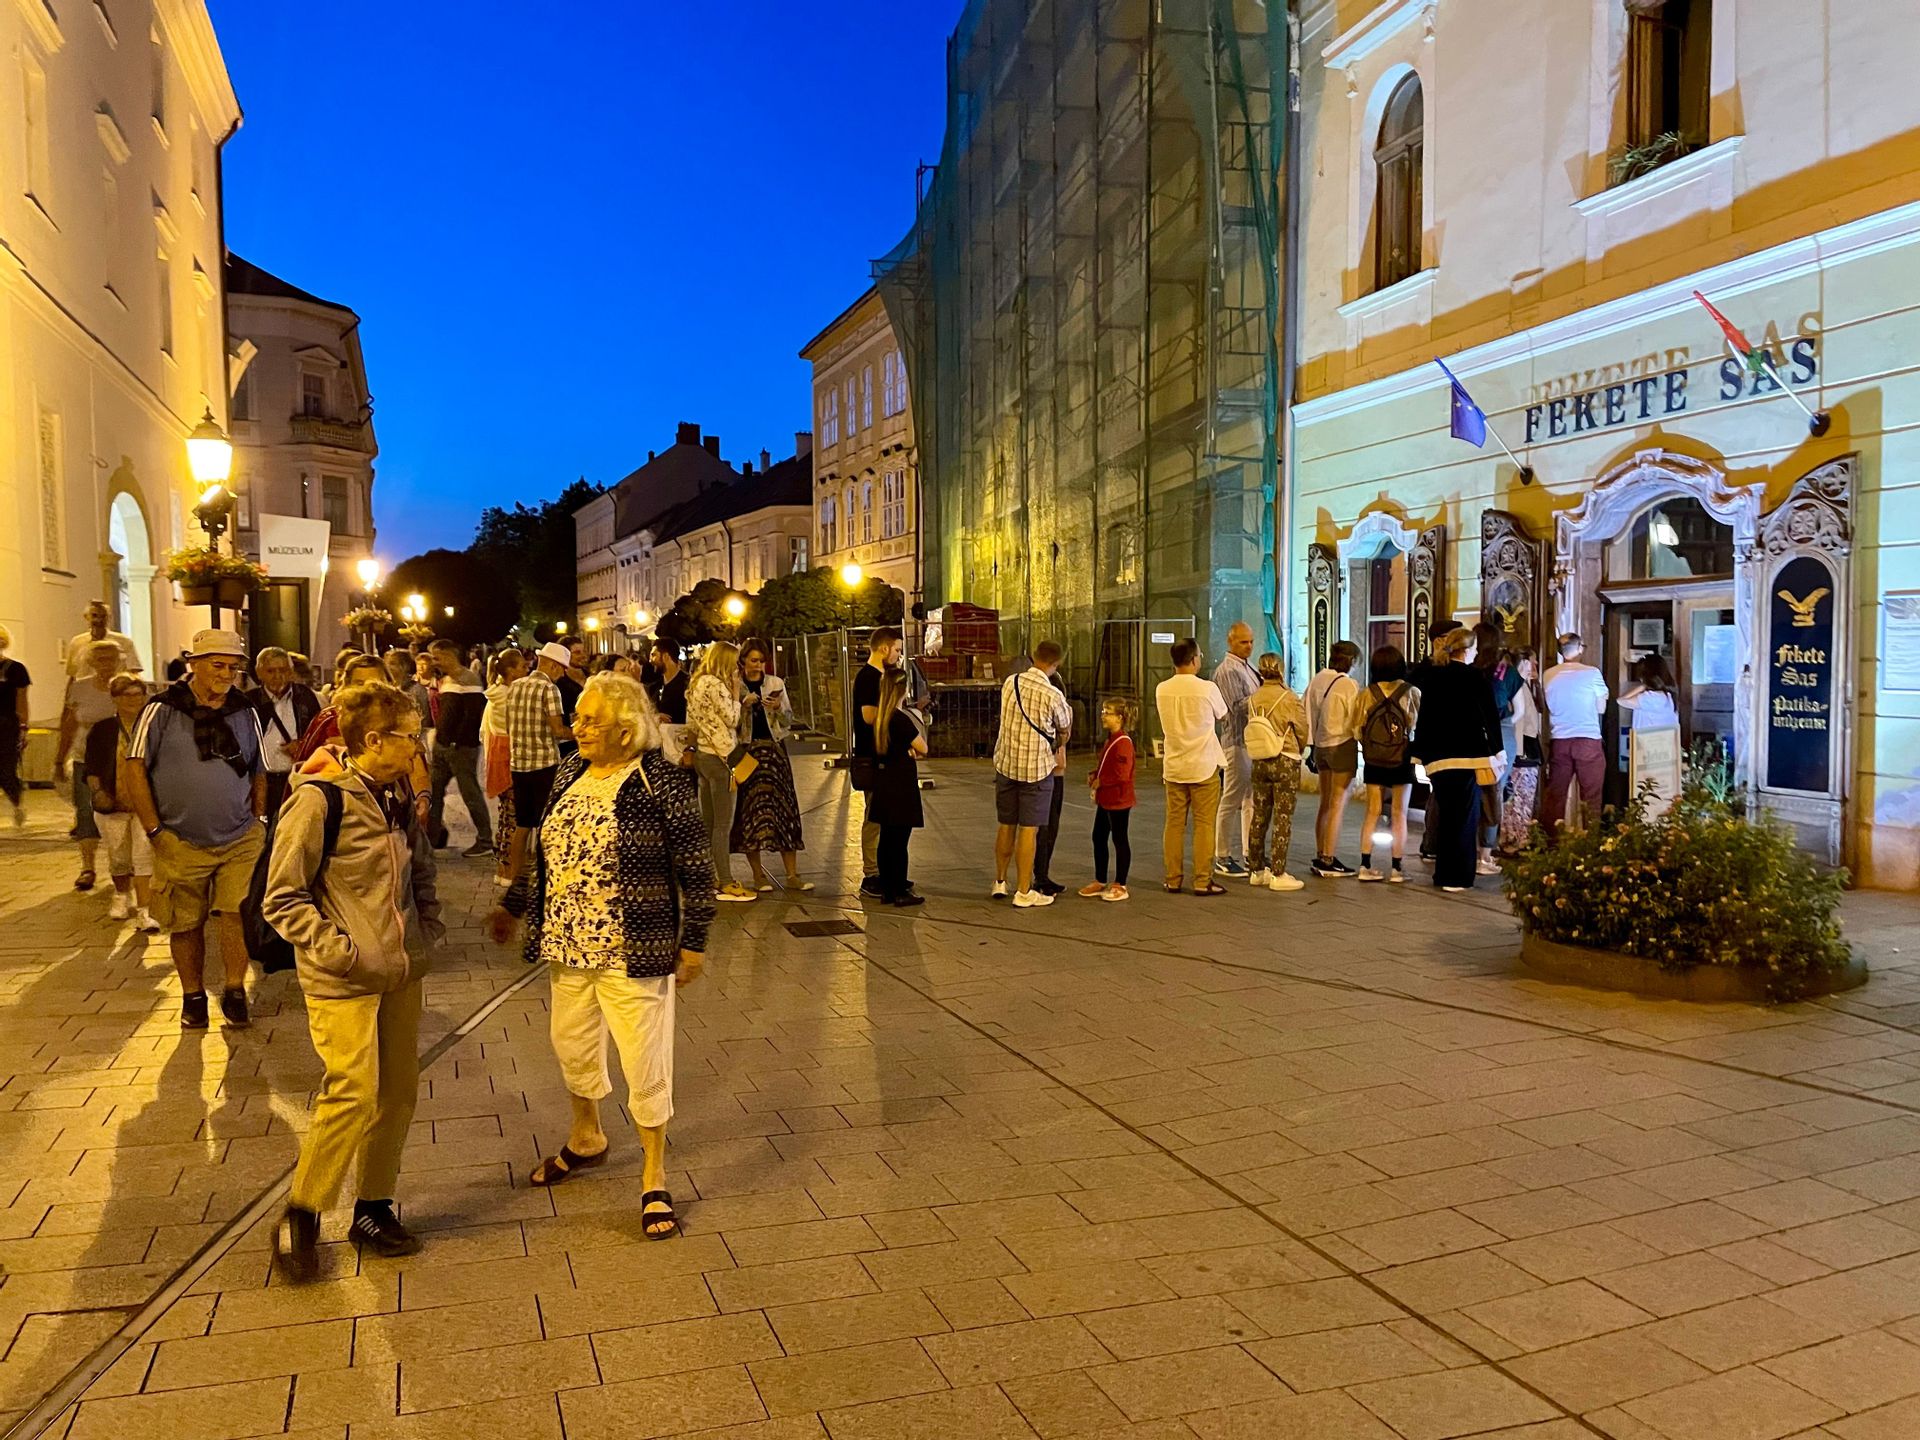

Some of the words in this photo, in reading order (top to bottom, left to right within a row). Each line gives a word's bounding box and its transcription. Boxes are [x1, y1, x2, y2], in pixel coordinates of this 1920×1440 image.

[1524, 369, 1688, 444] FEKETE
[1720, 338, 1816, 401] SAS
[1418, 623, 1426, 663] APOT
[1781, 667, 1817, 686] Sas
